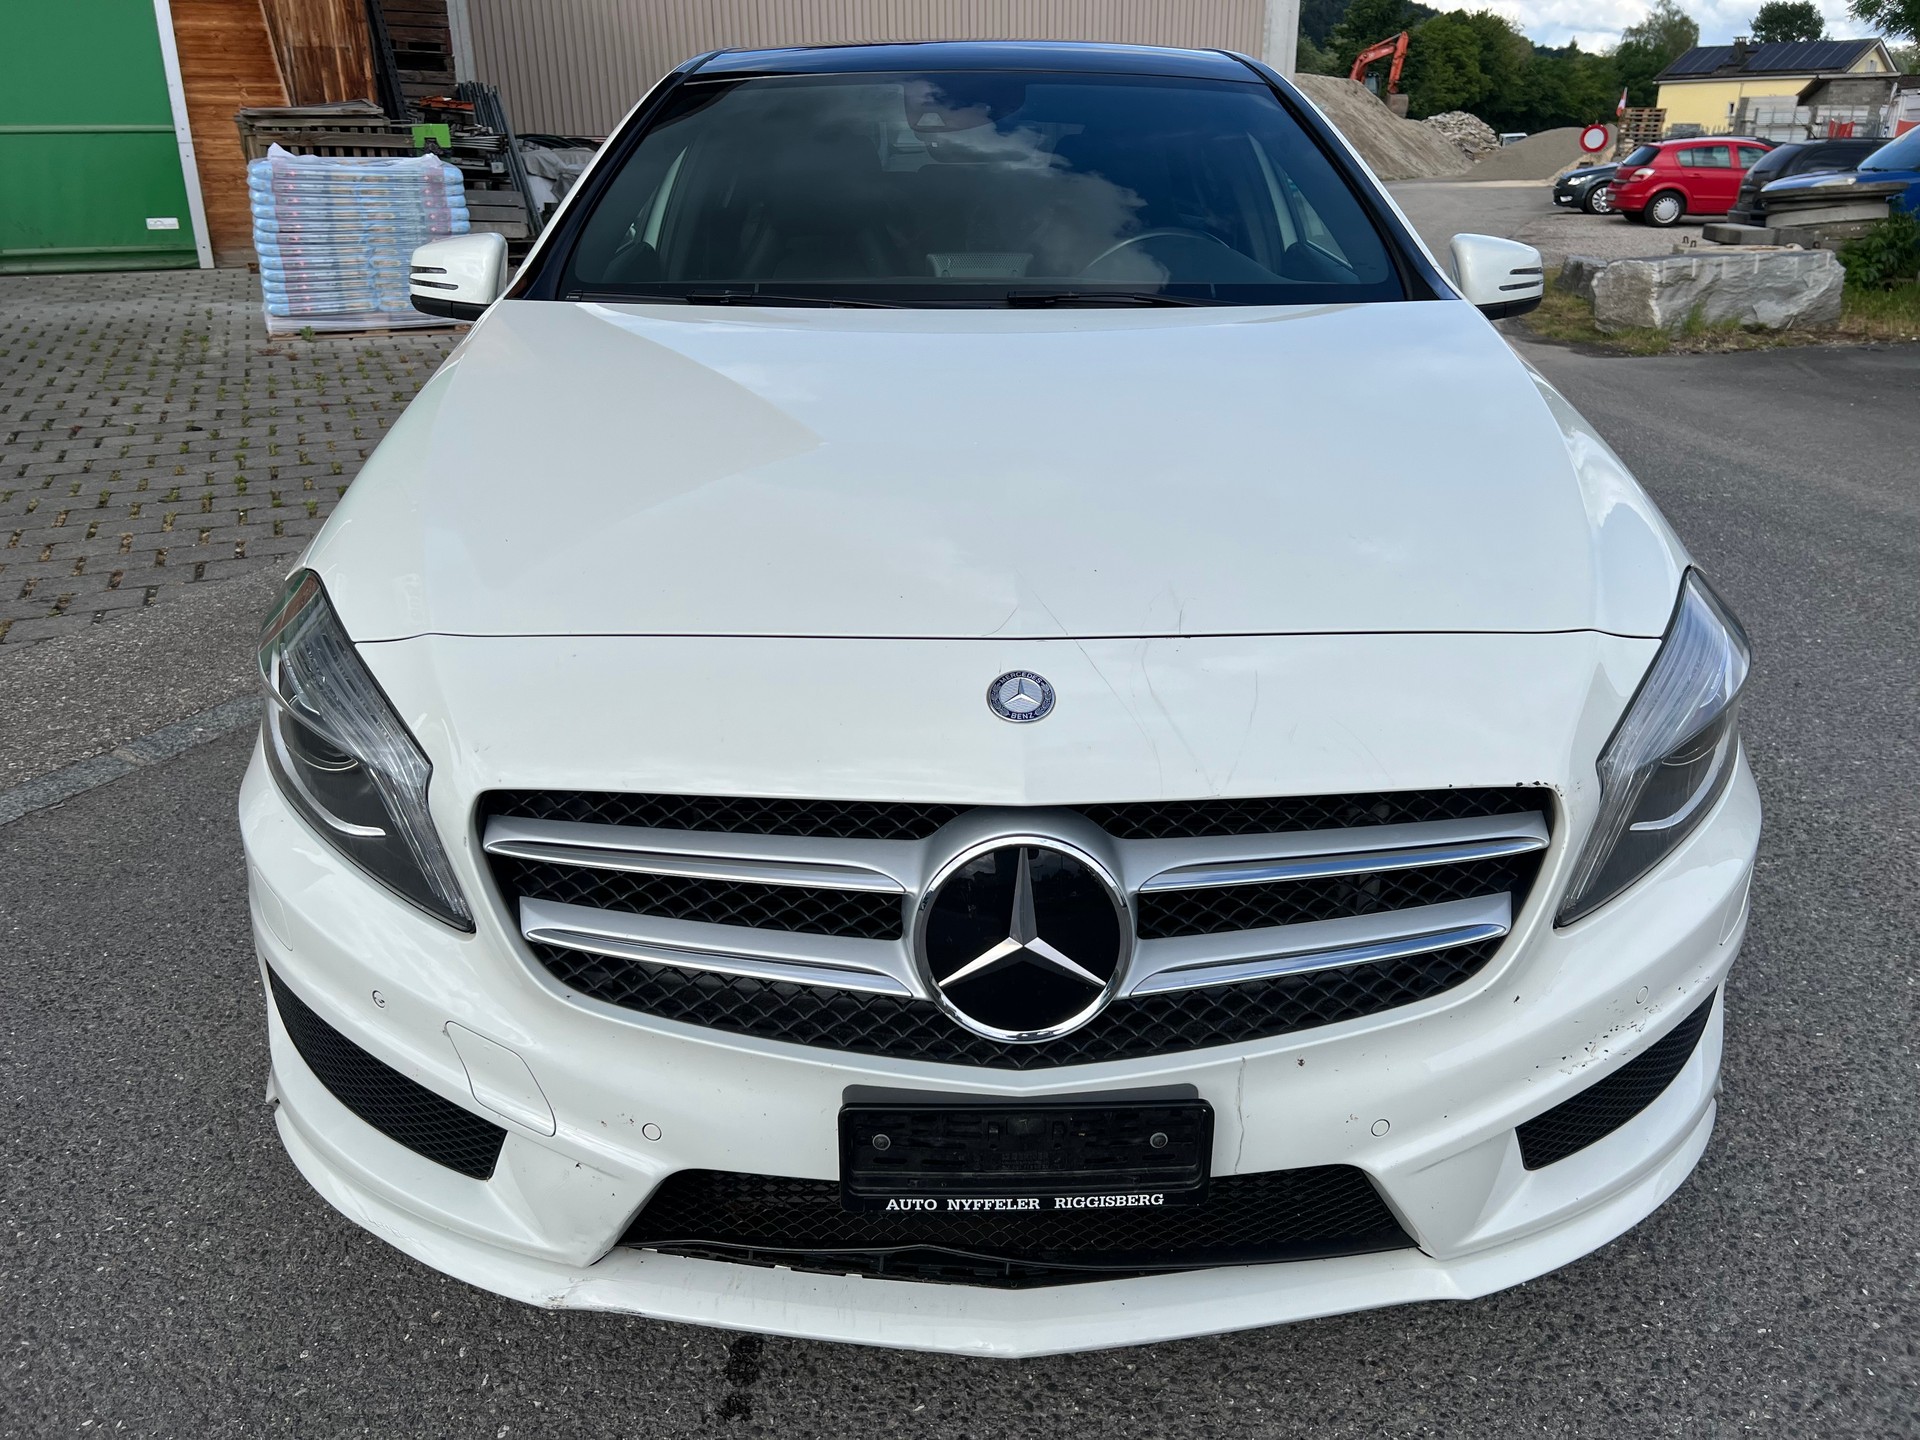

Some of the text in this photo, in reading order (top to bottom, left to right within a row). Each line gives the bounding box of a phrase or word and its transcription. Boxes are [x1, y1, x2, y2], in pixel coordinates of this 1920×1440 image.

[999, 671, 1042, 684] MERCEDES
[885, 1193, 1165, 1211] AUTO NYFFELER RIGGISBERG
